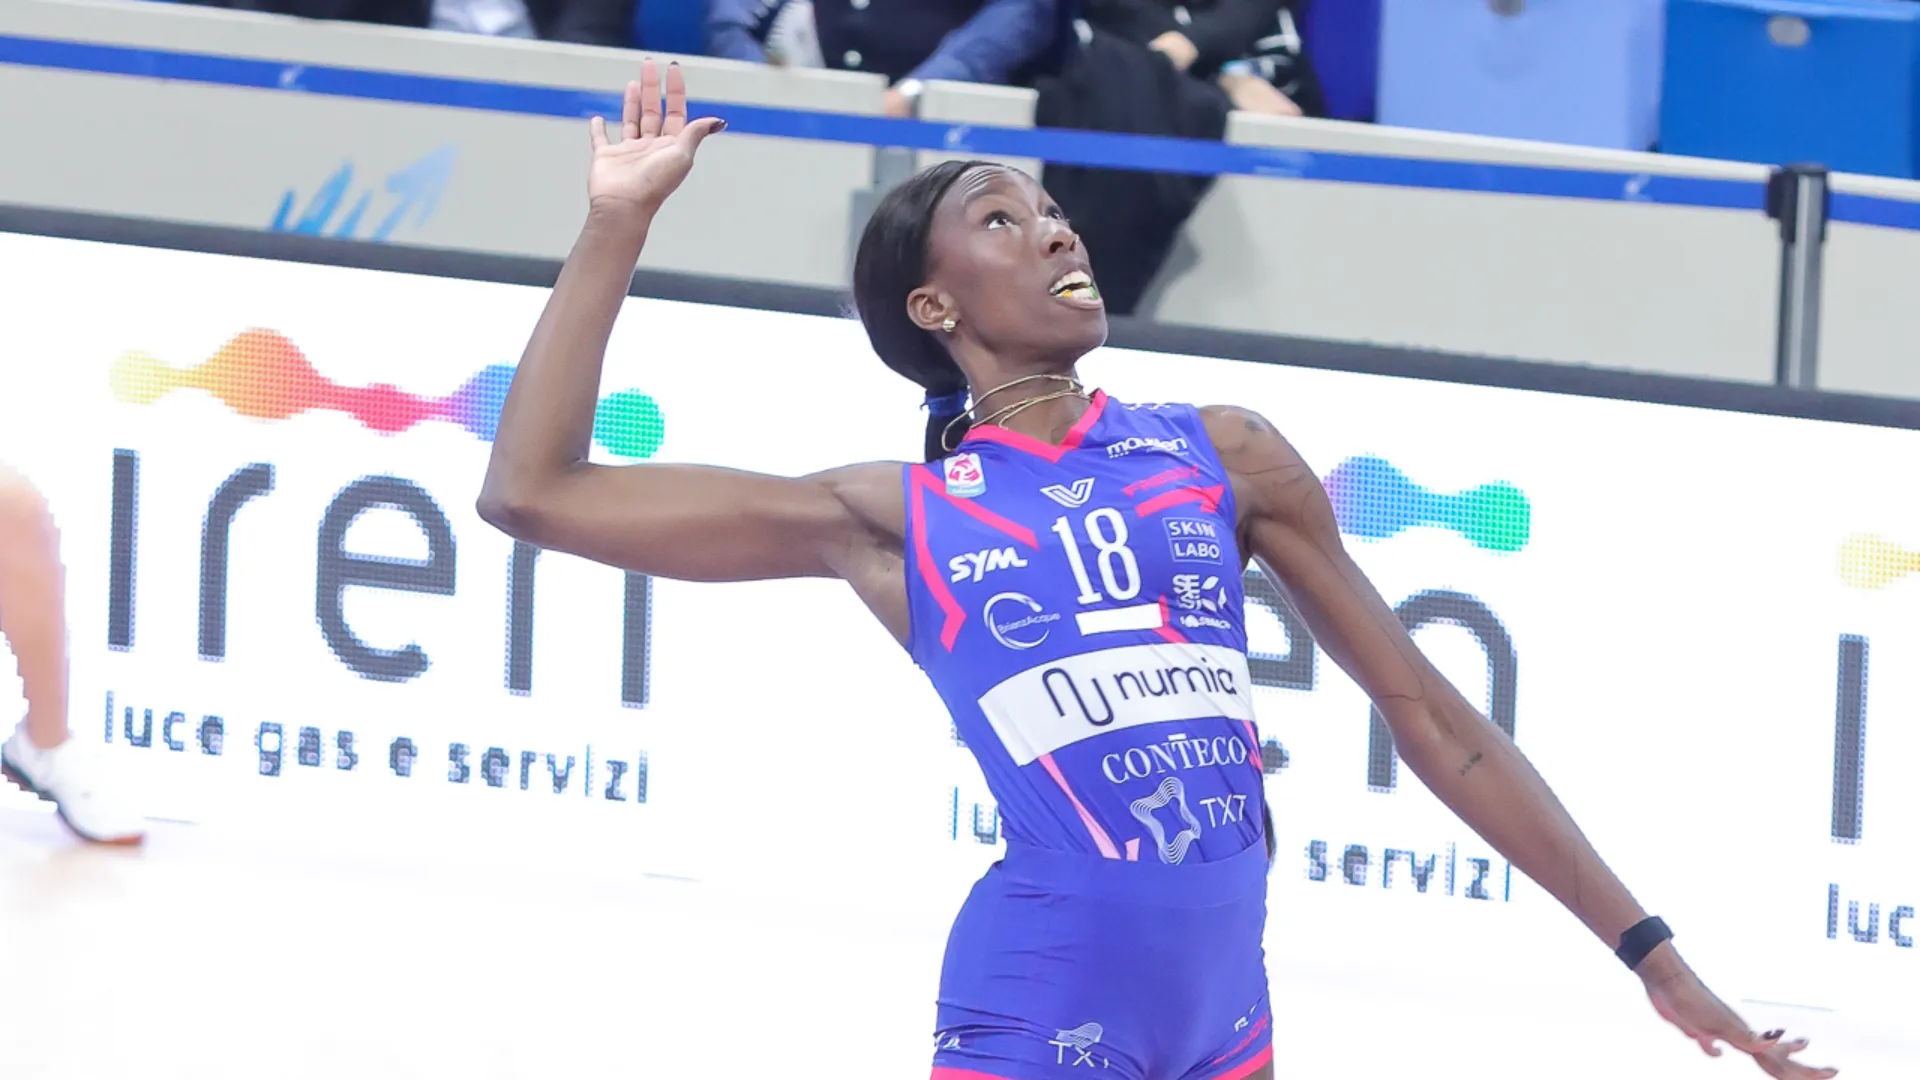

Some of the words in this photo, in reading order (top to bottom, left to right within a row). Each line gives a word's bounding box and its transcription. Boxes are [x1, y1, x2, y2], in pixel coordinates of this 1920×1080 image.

[1168, 521, 1216, 538] SKIN
[1174, 542, 1220, 559] LABO
[948, 546, 1029, 584] SYM
[1052, 507, 1142, 605] 18
[1113, 656, 1238, 700] numia
[104, 690, 225, 756] luce
[256, 720, 359, 777] gas
[389, 735, 419, 777] e
[447, 741, 649, 804] servizi
[1101, 732, 1247, 784] CONTECO
[1826, 882, 1915, 949] luc
